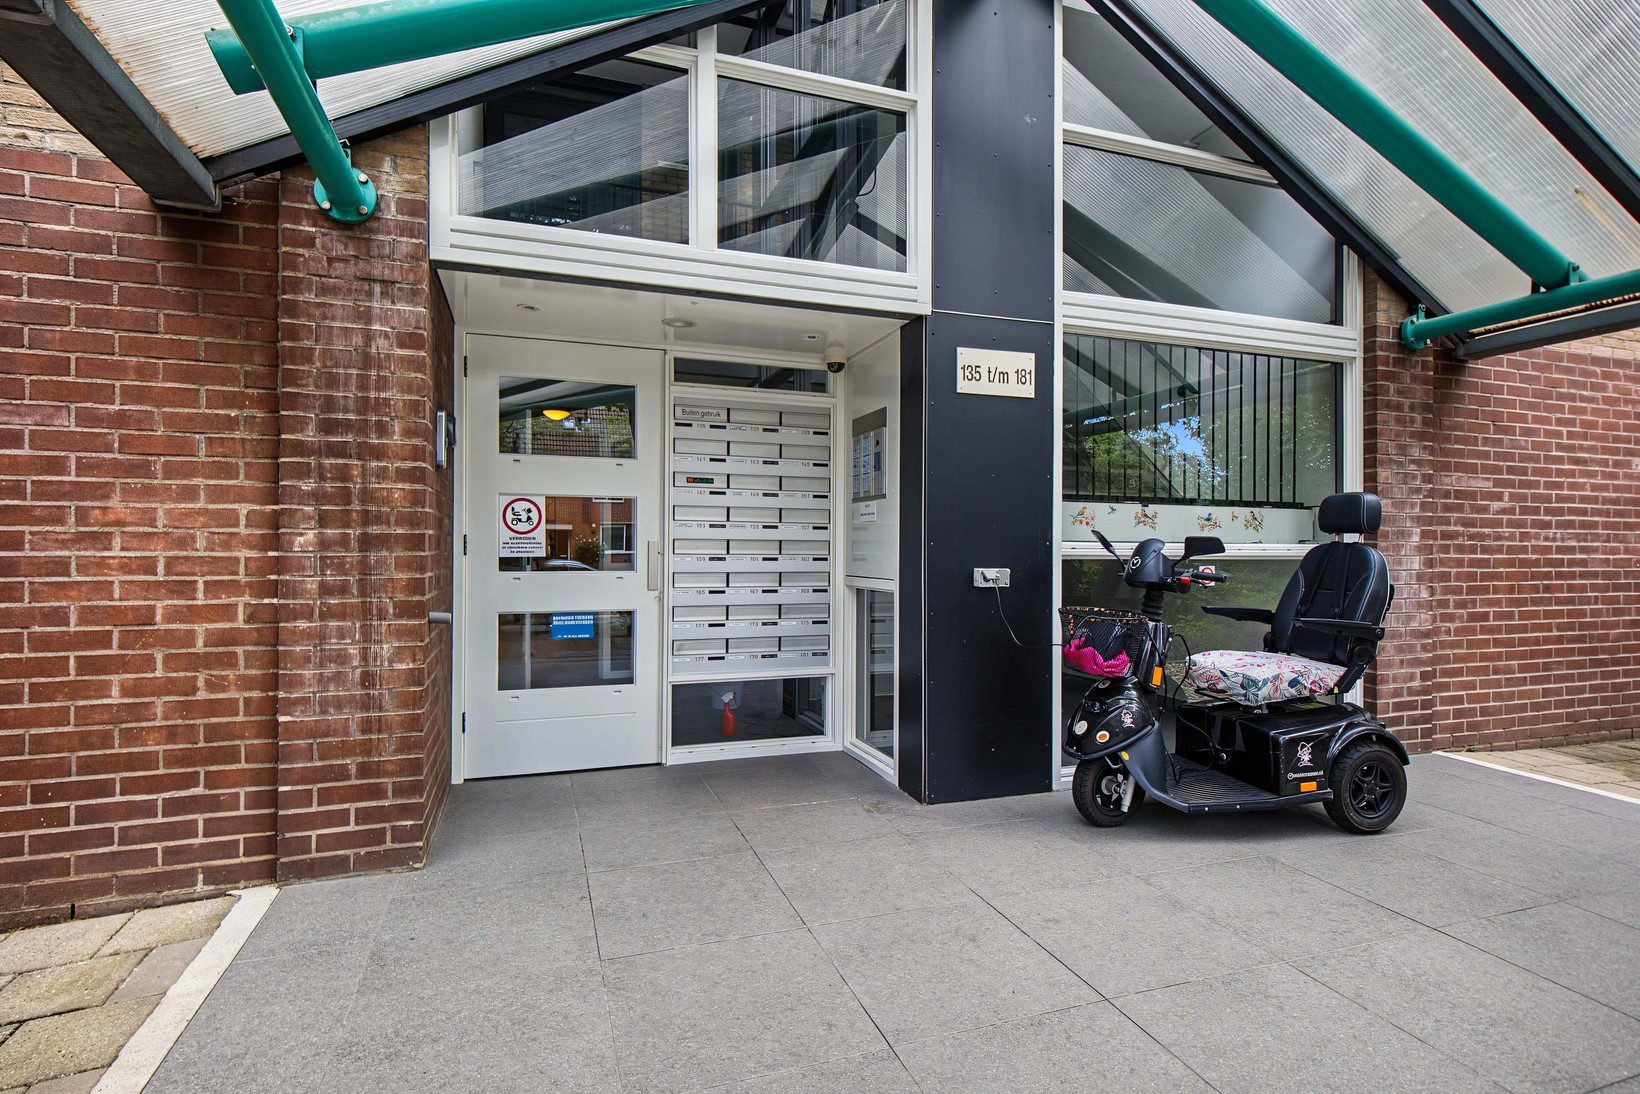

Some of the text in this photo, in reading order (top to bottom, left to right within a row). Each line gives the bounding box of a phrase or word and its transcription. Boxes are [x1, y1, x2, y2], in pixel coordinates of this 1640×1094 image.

[960, 364, 1032, 386] 135 t/m 181
[681, 408, 699, 416] Buiten
